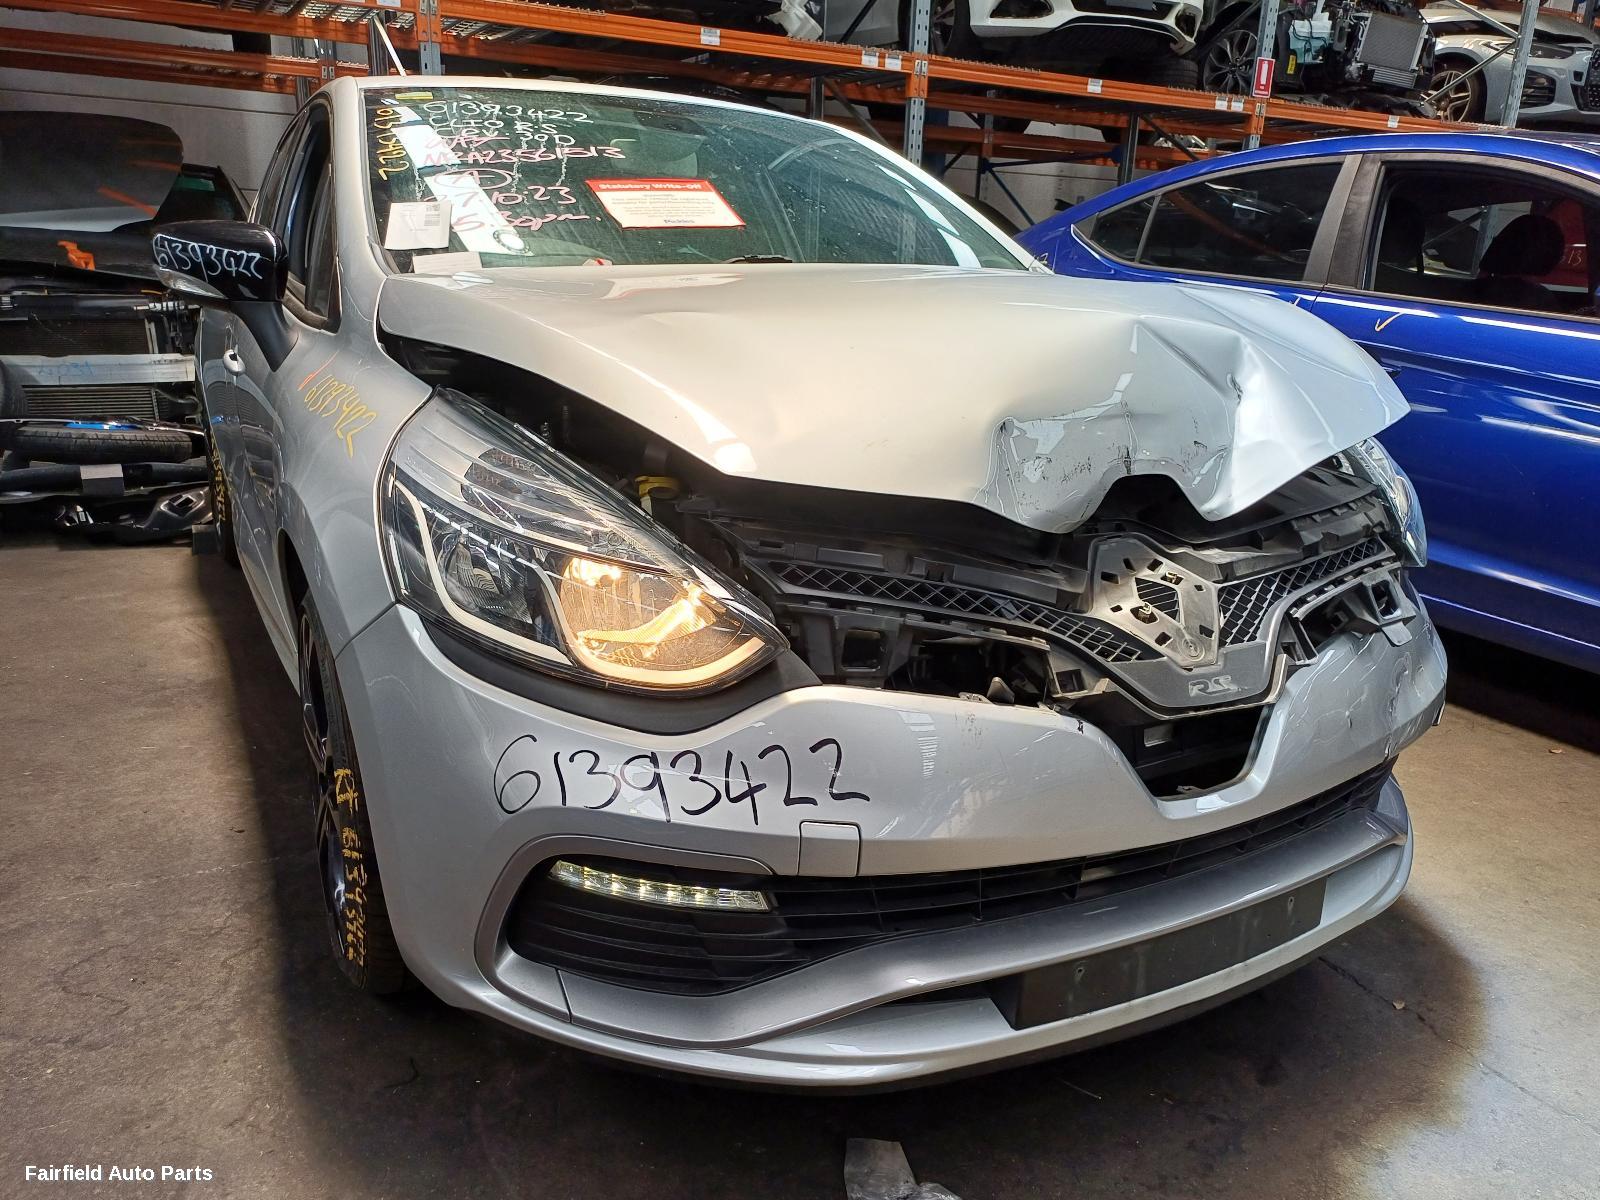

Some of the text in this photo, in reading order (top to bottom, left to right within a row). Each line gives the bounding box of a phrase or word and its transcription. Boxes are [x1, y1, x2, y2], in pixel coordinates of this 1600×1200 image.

[423, 100, 594, 123] 61393422
[153, 234, 263, 283] 61393422
[493, 734, 871, 826] 61393422
